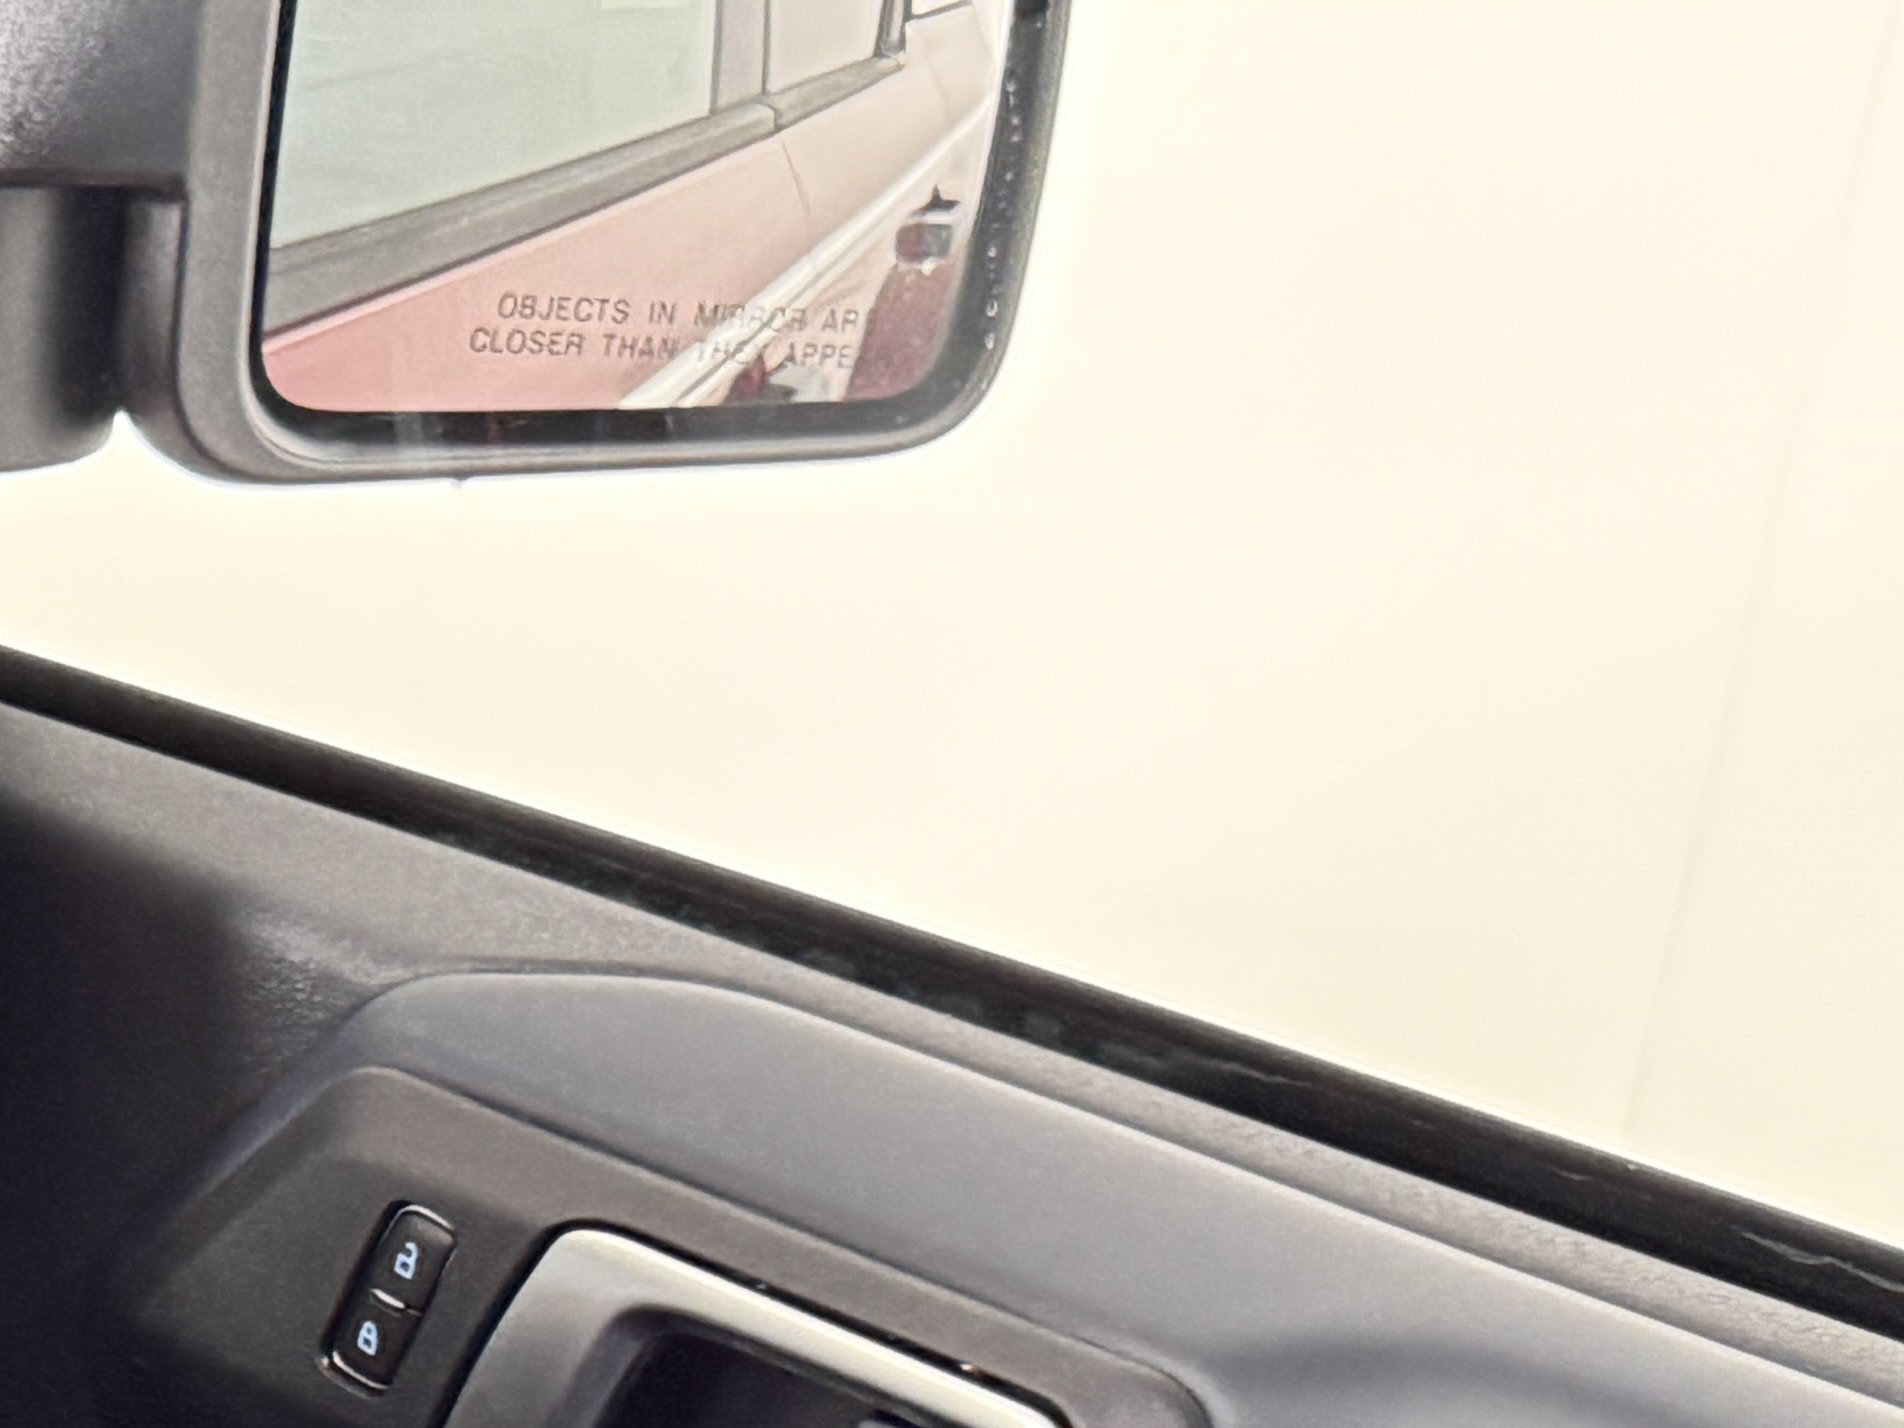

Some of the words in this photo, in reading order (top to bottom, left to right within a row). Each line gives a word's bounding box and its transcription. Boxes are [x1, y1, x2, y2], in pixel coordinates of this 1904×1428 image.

[496, 290, 631, 325] OBJECTS
[648, 300, 678, 327] IN
[468, 326, 585, 357] CLOSER
[601, 332, 678, 361] THAN
